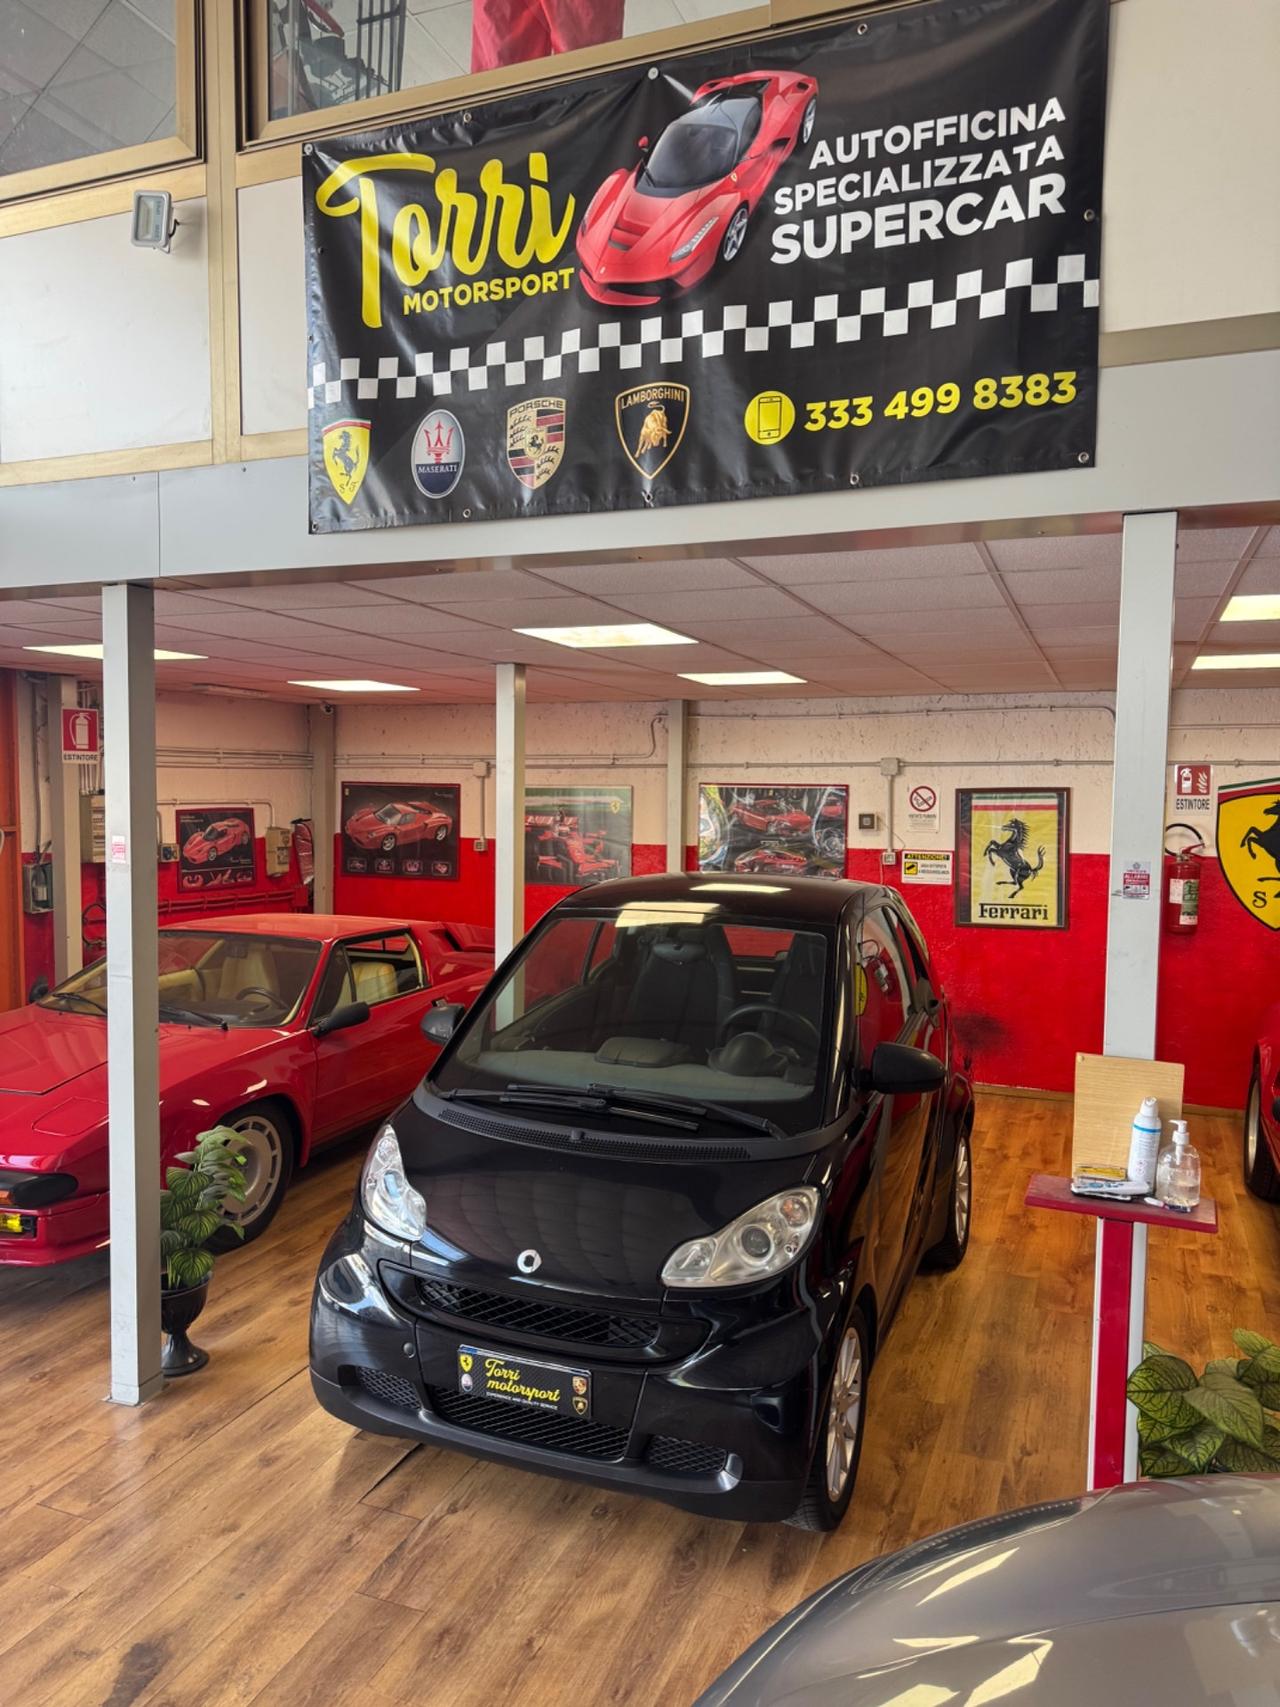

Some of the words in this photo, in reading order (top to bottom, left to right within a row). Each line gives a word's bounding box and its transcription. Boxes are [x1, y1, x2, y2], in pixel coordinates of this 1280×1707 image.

[809, 97, 1066, 170] AUTOFFICINA
[774, 135, 1065, 216] SPECIALIZZATA
[770, 173, 1066, 264] SUPERCAR
[316, 152, 575, 328] Torri
[403, 267, 575, 316] MOTORSPORT
[509, 401, 564, 417] PORSCHE
[621, 387, 685, 409] LAMBORGHINI
[804, 396, 873, 432] 333
[884, 383, 961, 420] 499
[973, 371, 1077, 410] 8383
[418, 464, 458, 474] MASERATI
[1175, 798, 1210, 811] ESTINTORE
[978, 903, 1049, 921] Ferrari
[484, 1358, 521, 1380] Torri
[487, 1378, 561, 1402] motorsport
